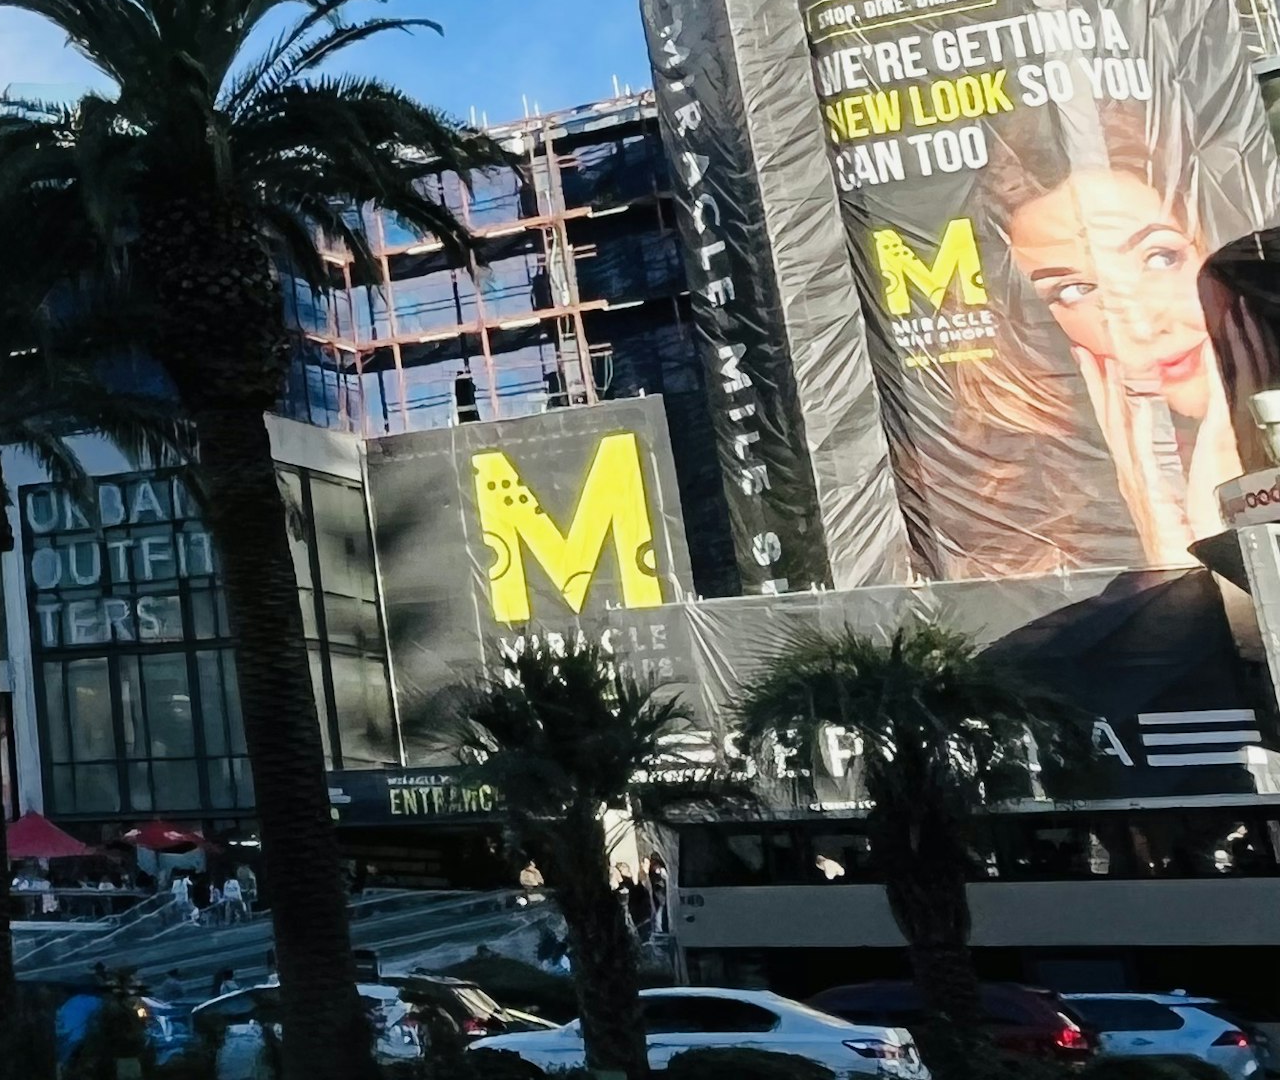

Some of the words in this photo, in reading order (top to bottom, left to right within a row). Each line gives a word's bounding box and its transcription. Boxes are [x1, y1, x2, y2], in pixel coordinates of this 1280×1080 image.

[818, 36, 928, 96] WE'RE
[932, 8, 1096, 72] GETTING
[1101, 8, 1129, 51] A
[826, 86, 900, 143] NEW
[908, 69, 1014, 126] LOOK
[1018, 60, 1074, 107] SO
[1078, 58, 1152, 101] YOU
[836, 140, 905, 192] CAN
[907, 126, 989, 176] TOO
[873, 218, 988, 315] M
[892, 310, 993, 334] MIRACLE
[472, 433, 663, 622] M
[31, 532, 220, 590] OUTFIT
[36, 596, 163, 647] TERS
[390, 784, 506, 816] ENTRNC
